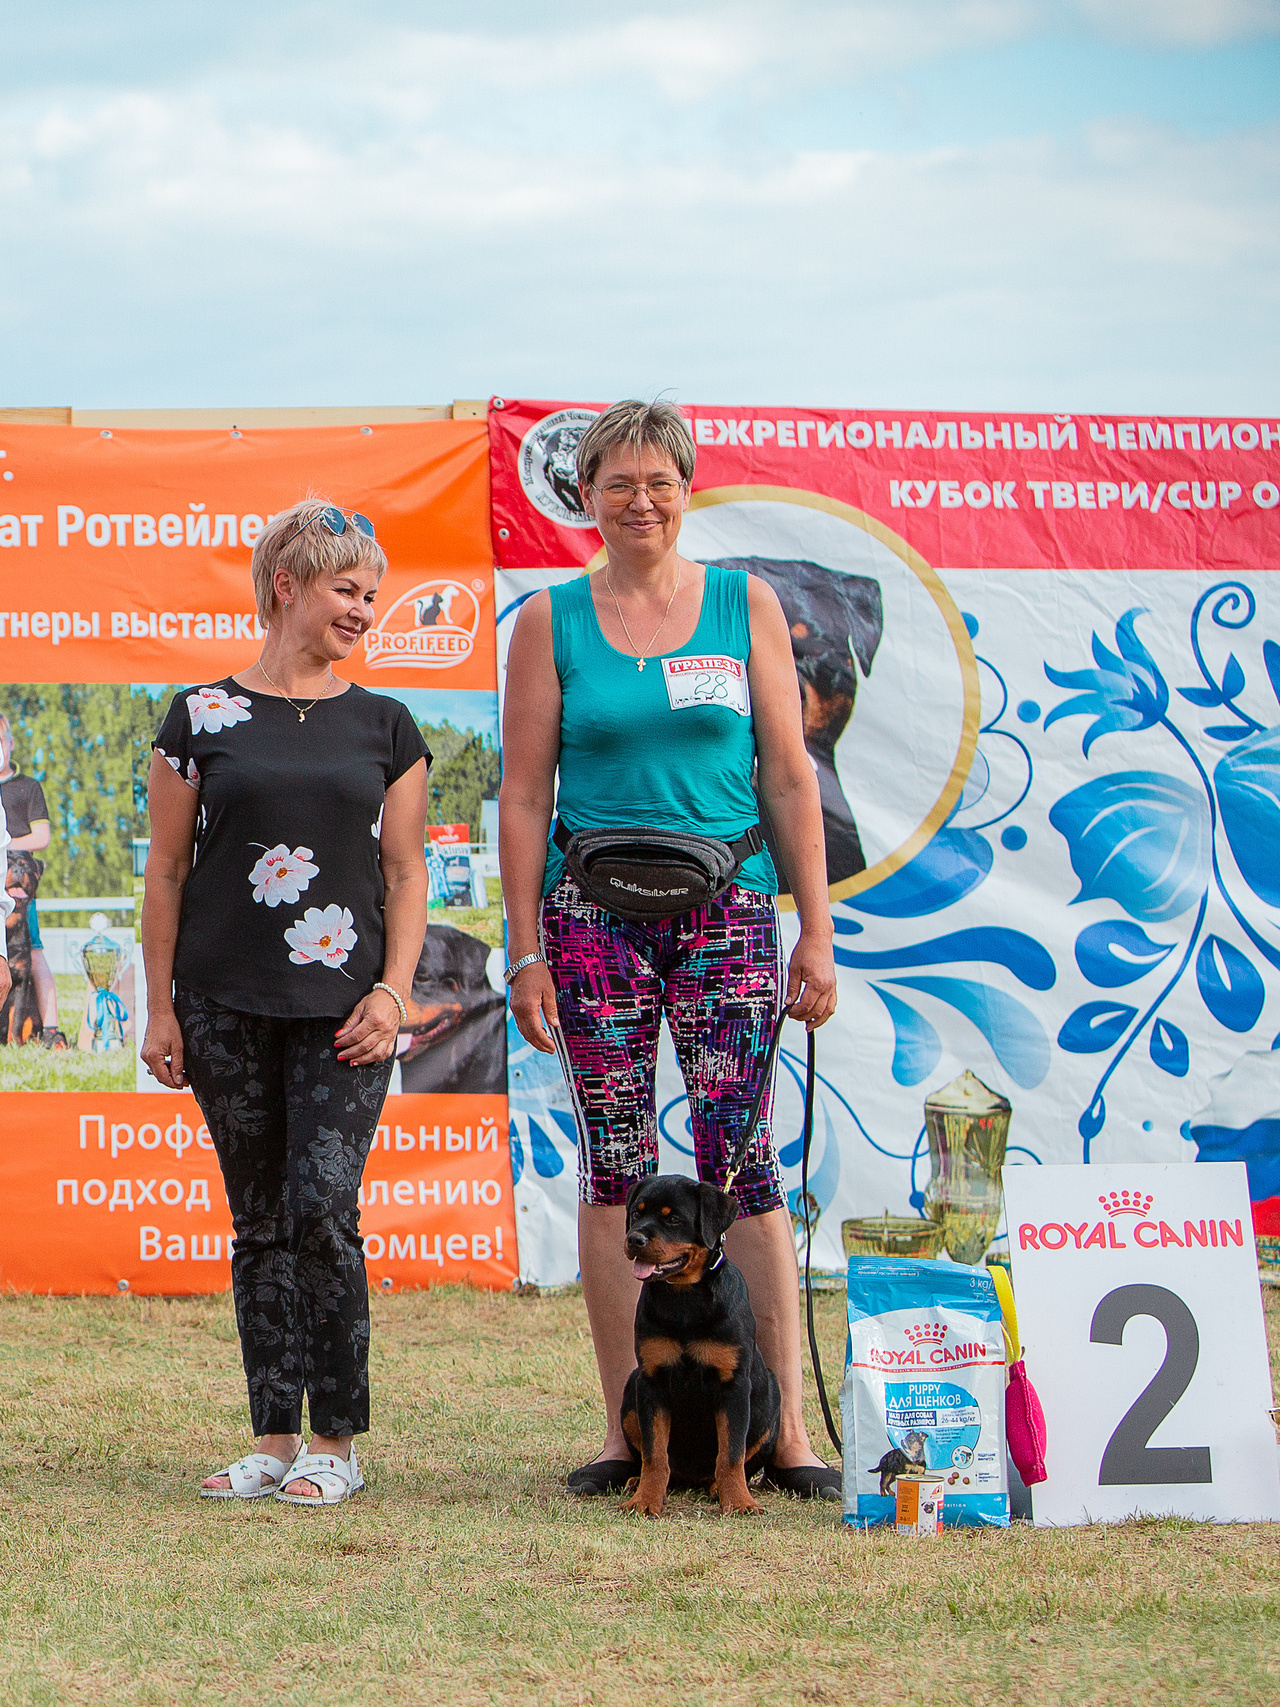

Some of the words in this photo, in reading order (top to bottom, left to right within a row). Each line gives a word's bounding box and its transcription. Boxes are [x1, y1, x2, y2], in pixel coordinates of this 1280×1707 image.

[687, 415, 1078, 450] ЕЖРЕГИОНАЛЬНЫЙ
[890, 480, 1019, 509] КУБОК
[1026, 481, 1242, 513] ТВЕРИ/CUP
[57, 502, 273, 548] Ротвейле
[365, 630, 472, 653] PROFIFEED
[671, 659, 741, 677] ТРАПЕЗА
[694, 672, 729, 699] 28
[56, 1178, 211, 1212] подход
[363, 1226, 504, 1267] омцев!
[1018, 1221, 1127, 1250] ROYAL
[1133, 1219, 1244, 1249] CANIN
[871, 1347, 925, 1366] ROYAL
[929, 1342, 987, 1364] CANIN
[908, 1383, 941, 1395] PUPPY
[1089, 1283, 1213, 1486] 2
[888, 1396, 912, 1409] ДЛЯ
[915, 1394, 962, 1408] ЩЕНКОВ
